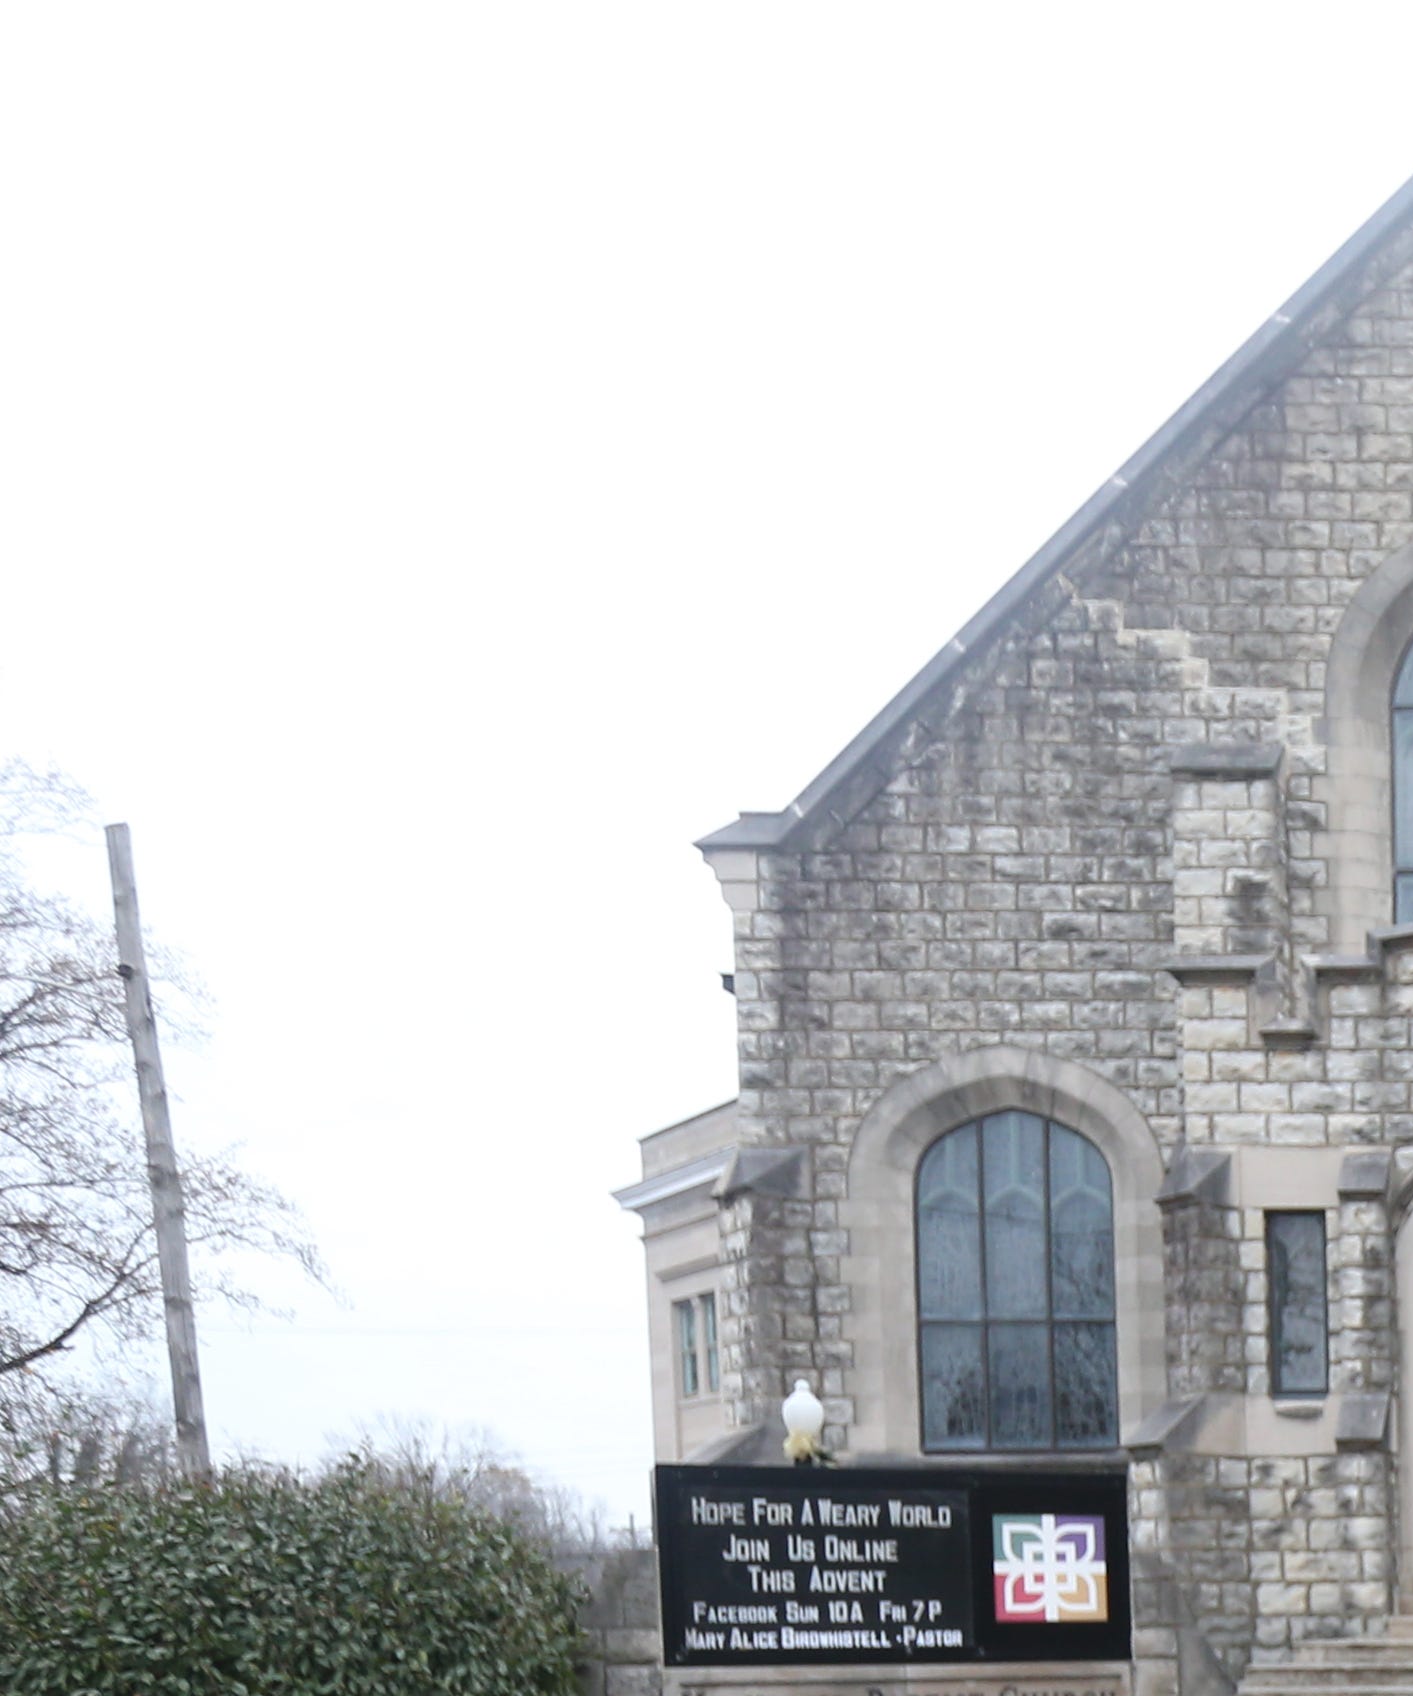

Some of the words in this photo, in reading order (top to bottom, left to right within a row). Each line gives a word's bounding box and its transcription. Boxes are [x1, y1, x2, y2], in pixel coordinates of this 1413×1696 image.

[691, 1497, 745, 1525] HOPE
[753, 1497, 793, 1526] FOR
[801, 1498, 814, 1526] A
[818, 1498, 881, 1527] WEARY
[888, 1499, 951, 1528] WORLD
[723, 1534, 770, 1562] JOIN
[787, 1534, 815, 1562] US
[824, 1534, 899, 1562] ONLINE
[748, 1564, 796, 1592] THIS
[809, 1565, 887, 1593] ADVENT
[693, 1601, 778, 1624] FACEBOOK
[785, 1601, 819, 1624] SUN
[879, 1600, 906, 1623] FRI
[685, 1626, 725, 1650] MARY
[730, 1626, 778, 1650] ALICE
